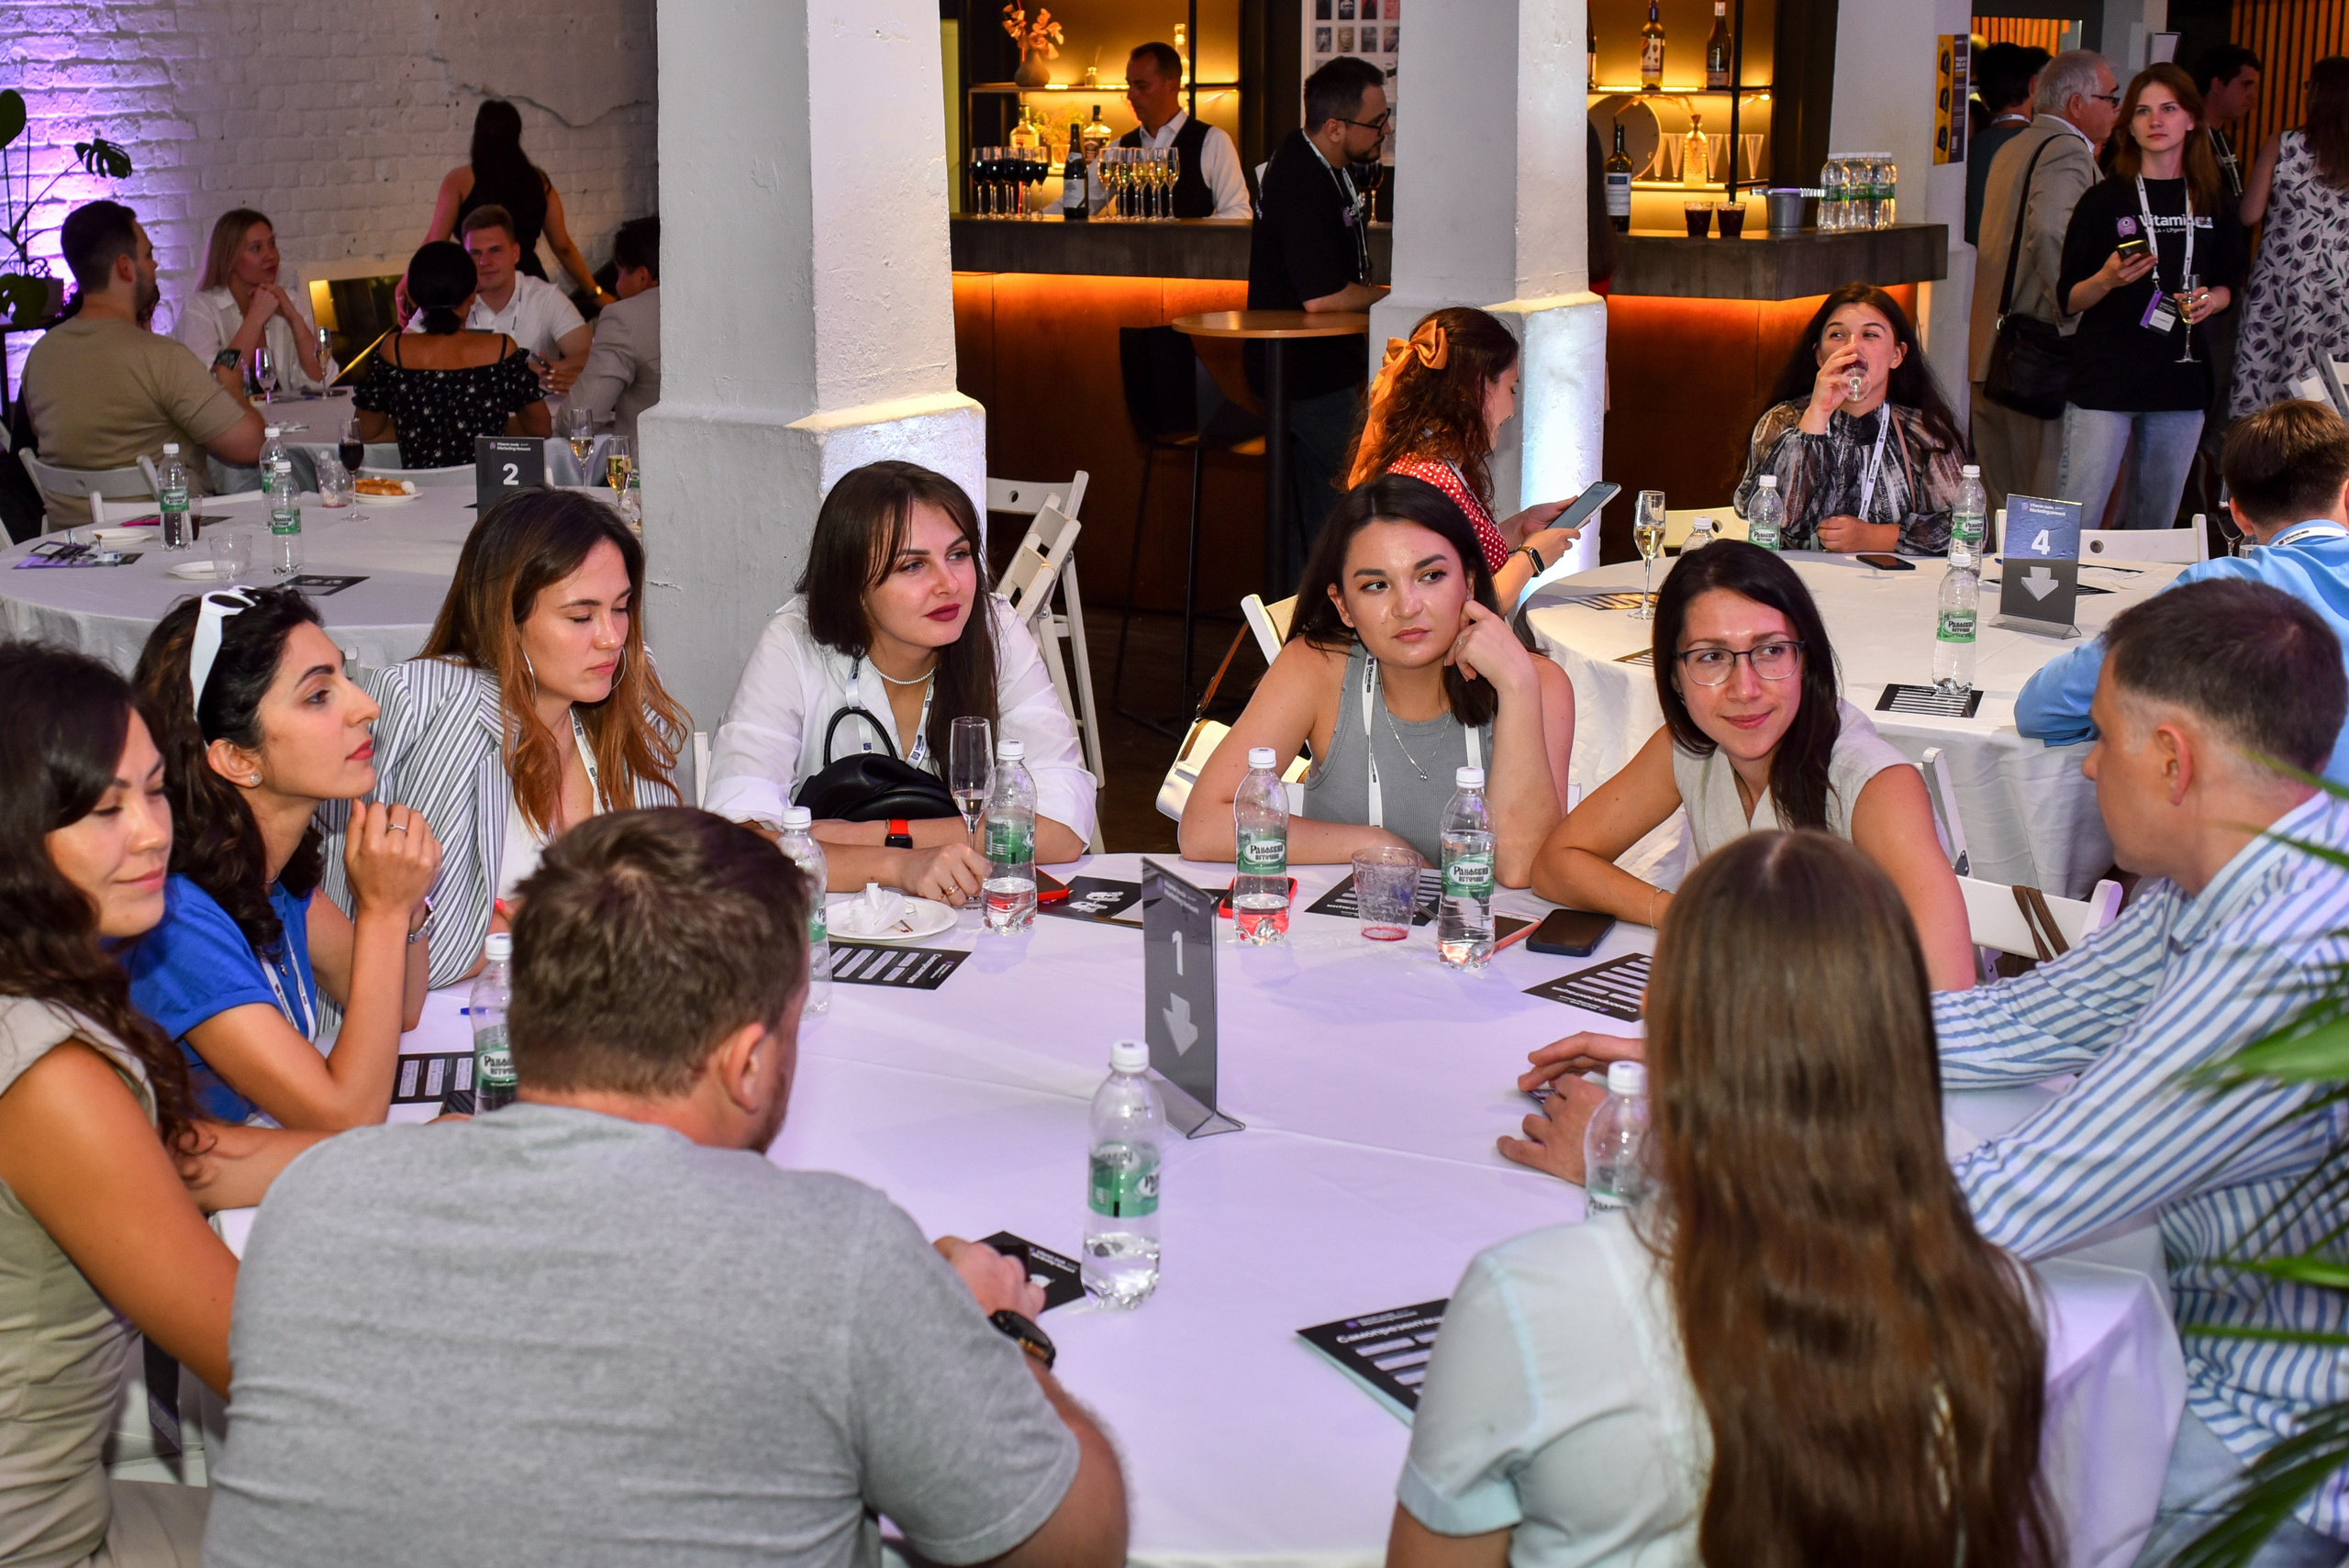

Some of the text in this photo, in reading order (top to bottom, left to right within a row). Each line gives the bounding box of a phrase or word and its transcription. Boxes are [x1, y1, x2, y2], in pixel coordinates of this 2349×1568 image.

[502, 462, 519, 485] 2
[2031, 528, 2051, 556] 4
[1172, 929, 1184, 976] 1
